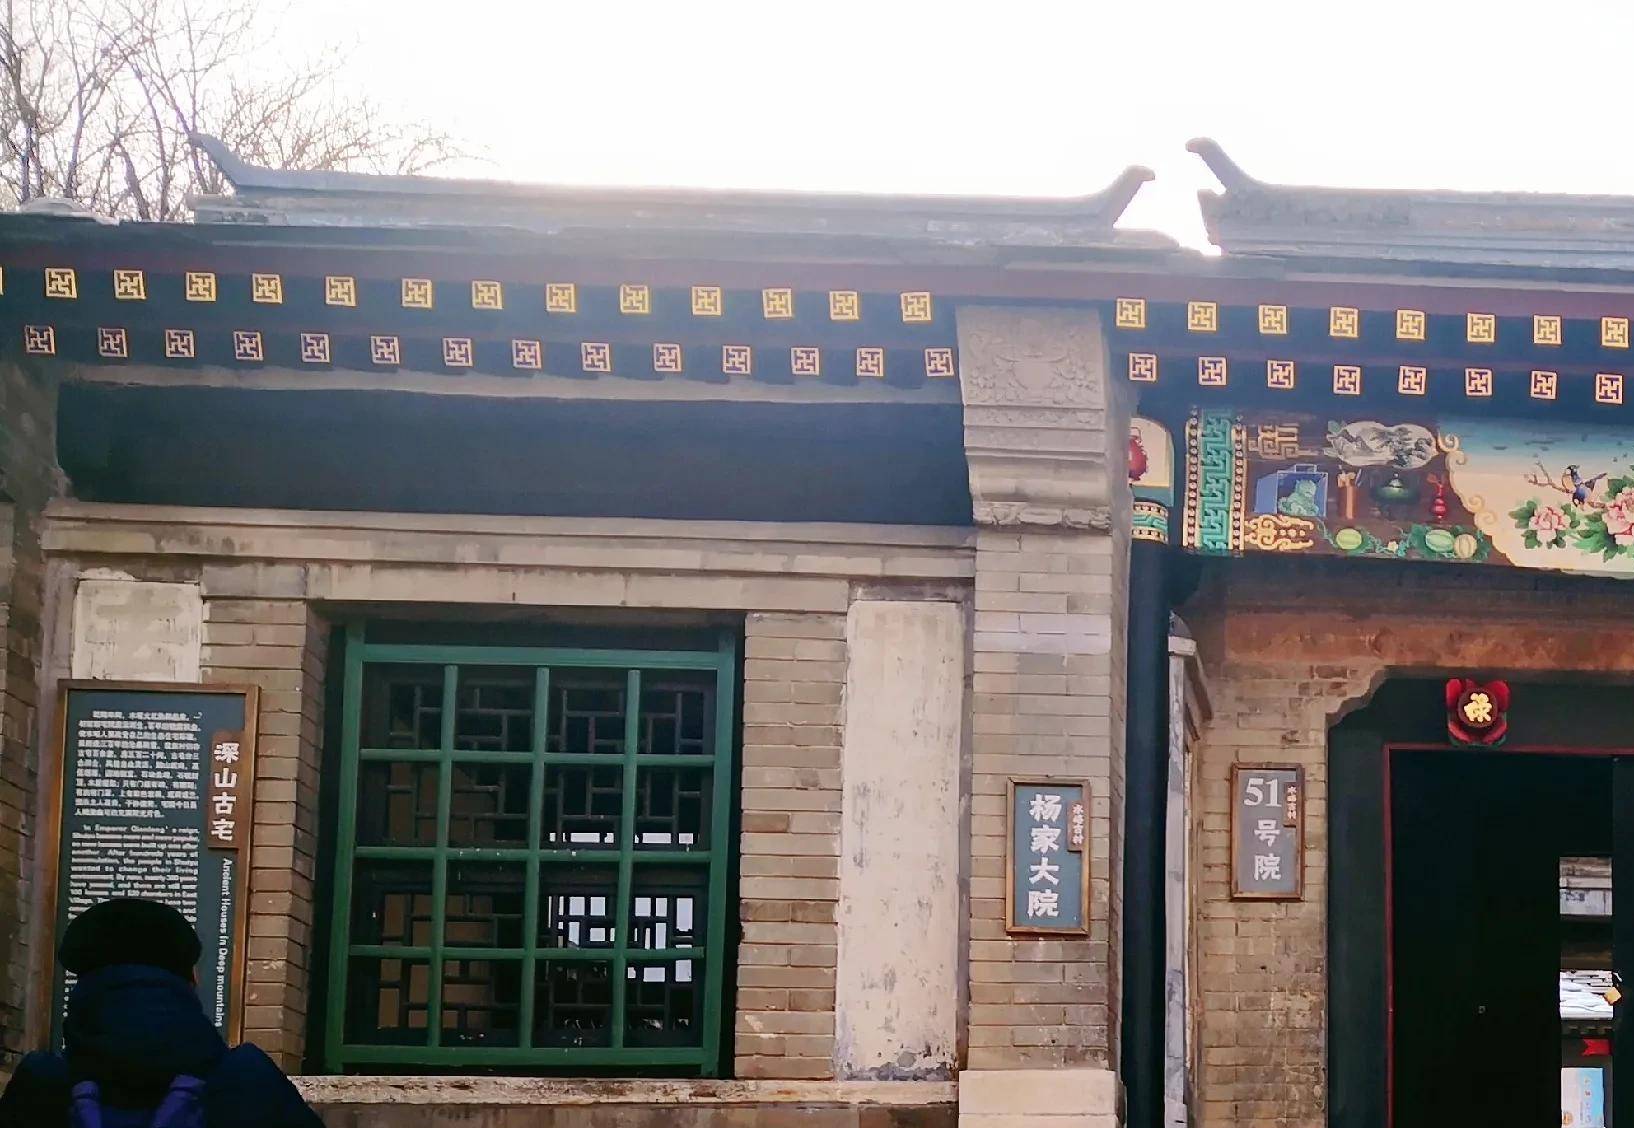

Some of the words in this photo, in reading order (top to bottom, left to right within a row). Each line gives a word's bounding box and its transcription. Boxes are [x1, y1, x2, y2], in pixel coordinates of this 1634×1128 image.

[211, 742, 240, 841] 深山古宅
[1242, 776, 1283, 882] 51号院
[222, 858, 232, 895] Ancient
[1026, 792, 1062, 919] 杨家大院
[220, 899, 231, 933] Houses
[217, 948, 228, 973] Deep
[219, 936, 229, 945] in
[215, 975, 224, 1026] mountains
